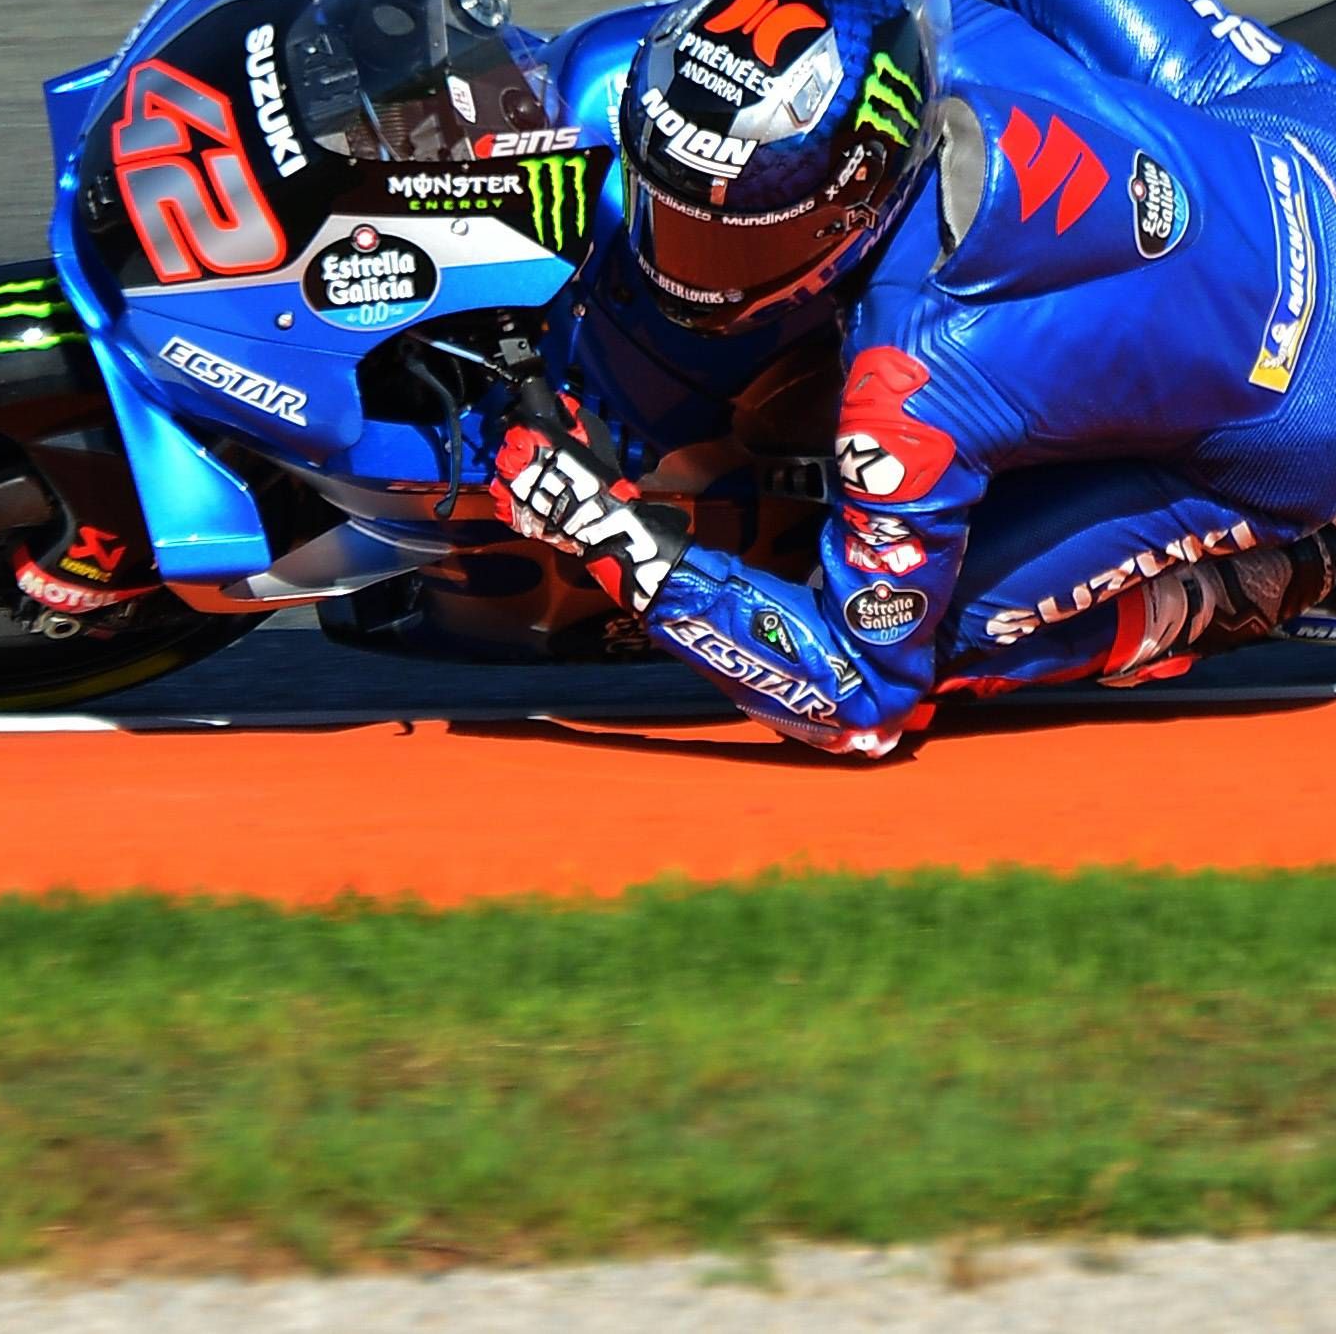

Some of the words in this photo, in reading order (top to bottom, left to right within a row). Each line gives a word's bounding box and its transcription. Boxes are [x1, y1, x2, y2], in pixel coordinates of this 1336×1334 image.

[678, 34, 777, 98] PYRÉNÉES
[678, 61, 744, 107] ANDORRA
[245, 23, 309, 178] SUZUKI
[641, 88, 760, 168] NOLAN
[112, 59, 287, 283] 42
[387, 172, 524, 198] MONSTER
[1142, 162, 1160, 237] Estrella
[409, 199, 503, 210] ENERGY
[1156, 170, 1173, 238] Galicia
[1271, 155, 1306, 317] MICHELIN
[321, 251, 416, 281] Estrella
[327, 276, 415, 305] Galicia
[685, 288, 724, 304] LOVERS
[160, 336, 308, 427] ECSTAR
[18, 571, 119, 607] MOTUL
[858, 598, 914, 616] Estrella
[986, 520, 1257, 644] SUZUKI
[859, 611, 913, 629] Galicia
[664, 617, 839, 728] ECSTAR
